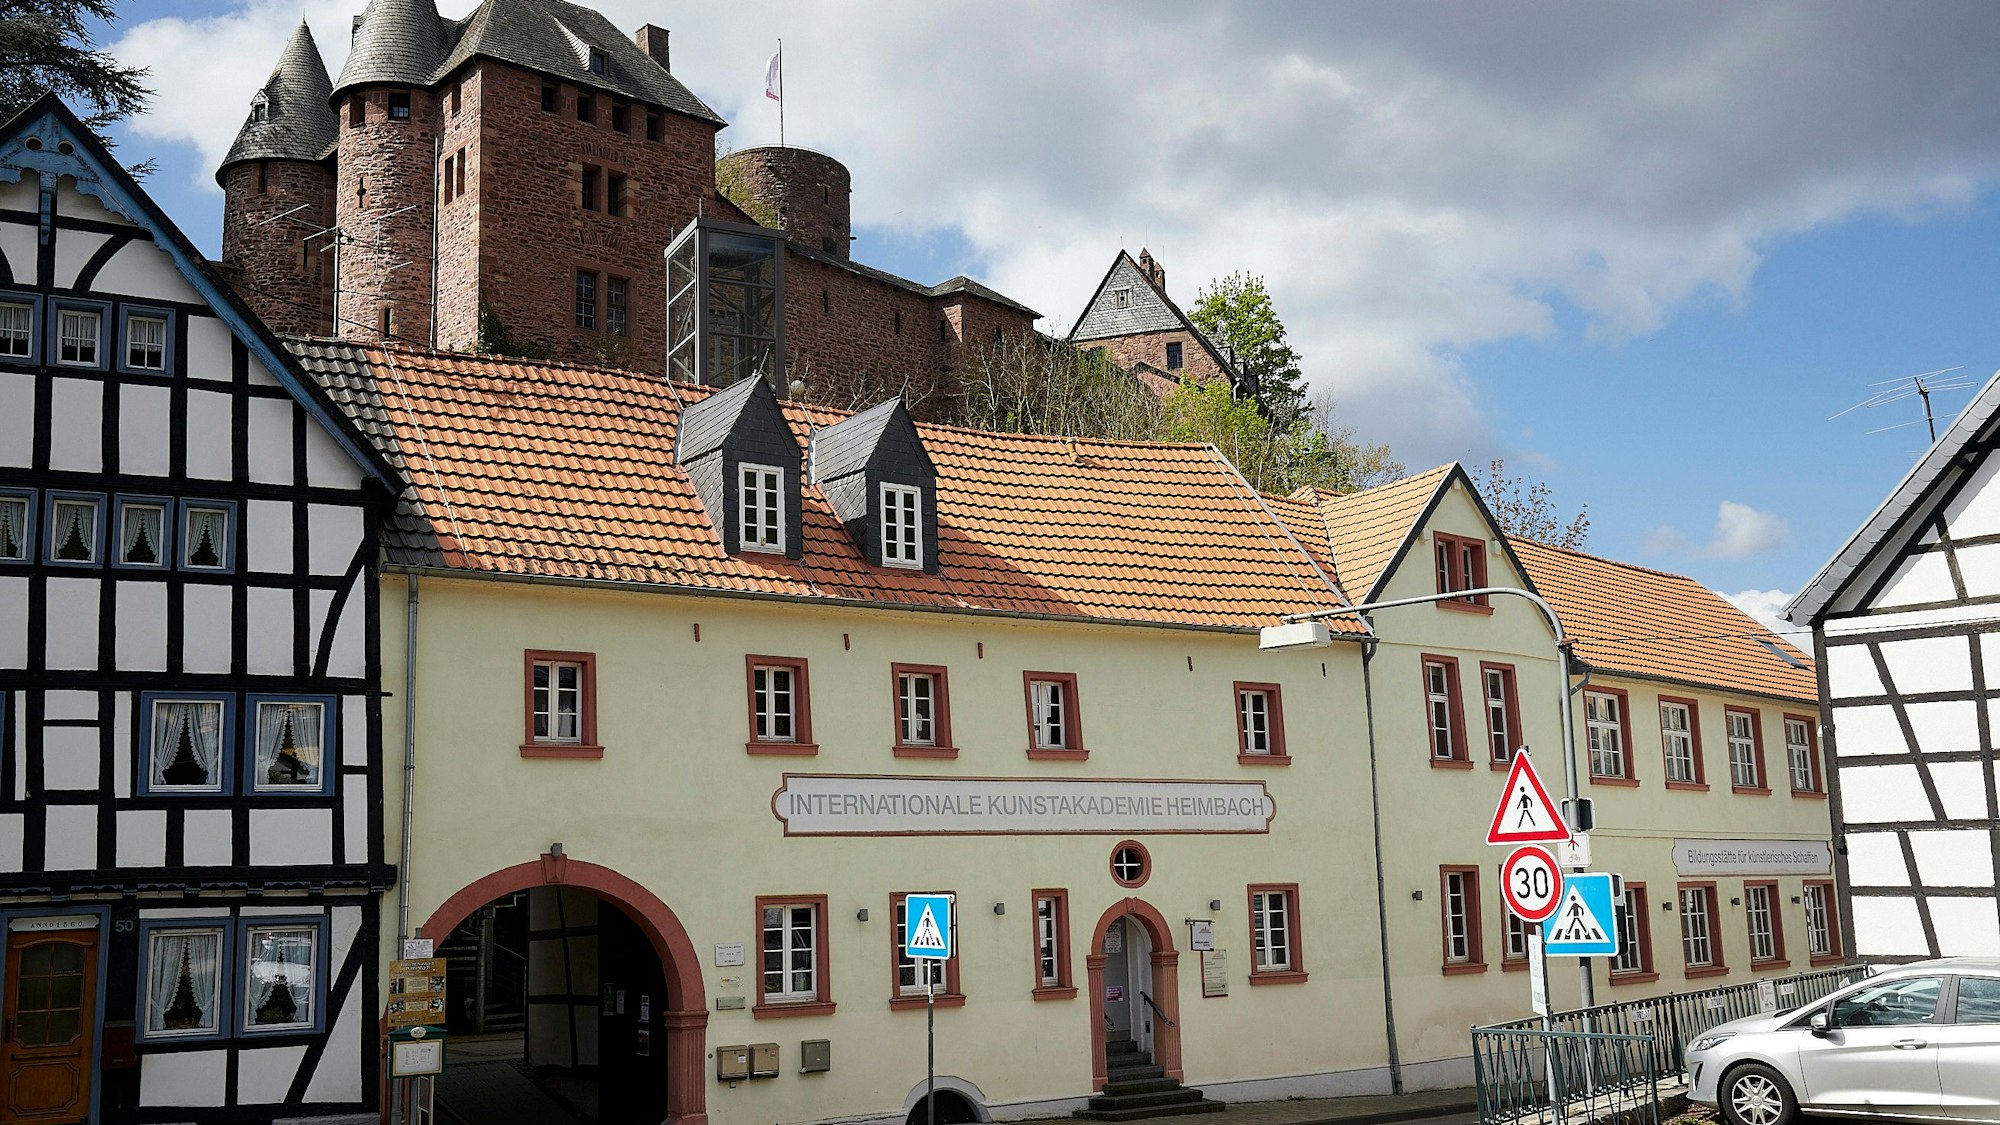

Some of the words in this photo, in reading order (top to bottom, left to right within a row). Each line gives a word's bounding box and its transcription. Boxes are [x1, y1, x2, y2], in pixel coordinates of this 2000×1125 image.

[789, 793, 983, 816] INTERNATIONALE
[988, 795, 1163, 816] KUNSTAKADEMIE
[1167, 797, 1265, 816] HEIMBACH
[1688, 849, 1736, 867] Bildungsstätte
[1737, 850, 1747, 864] für
[1747, 849, 1792, 864] künstlerisches
[1792, 850, 1819, 864] Schaffen
[1515, 867, 1549, 899] 30
[115, 920, 134, 933] 50
